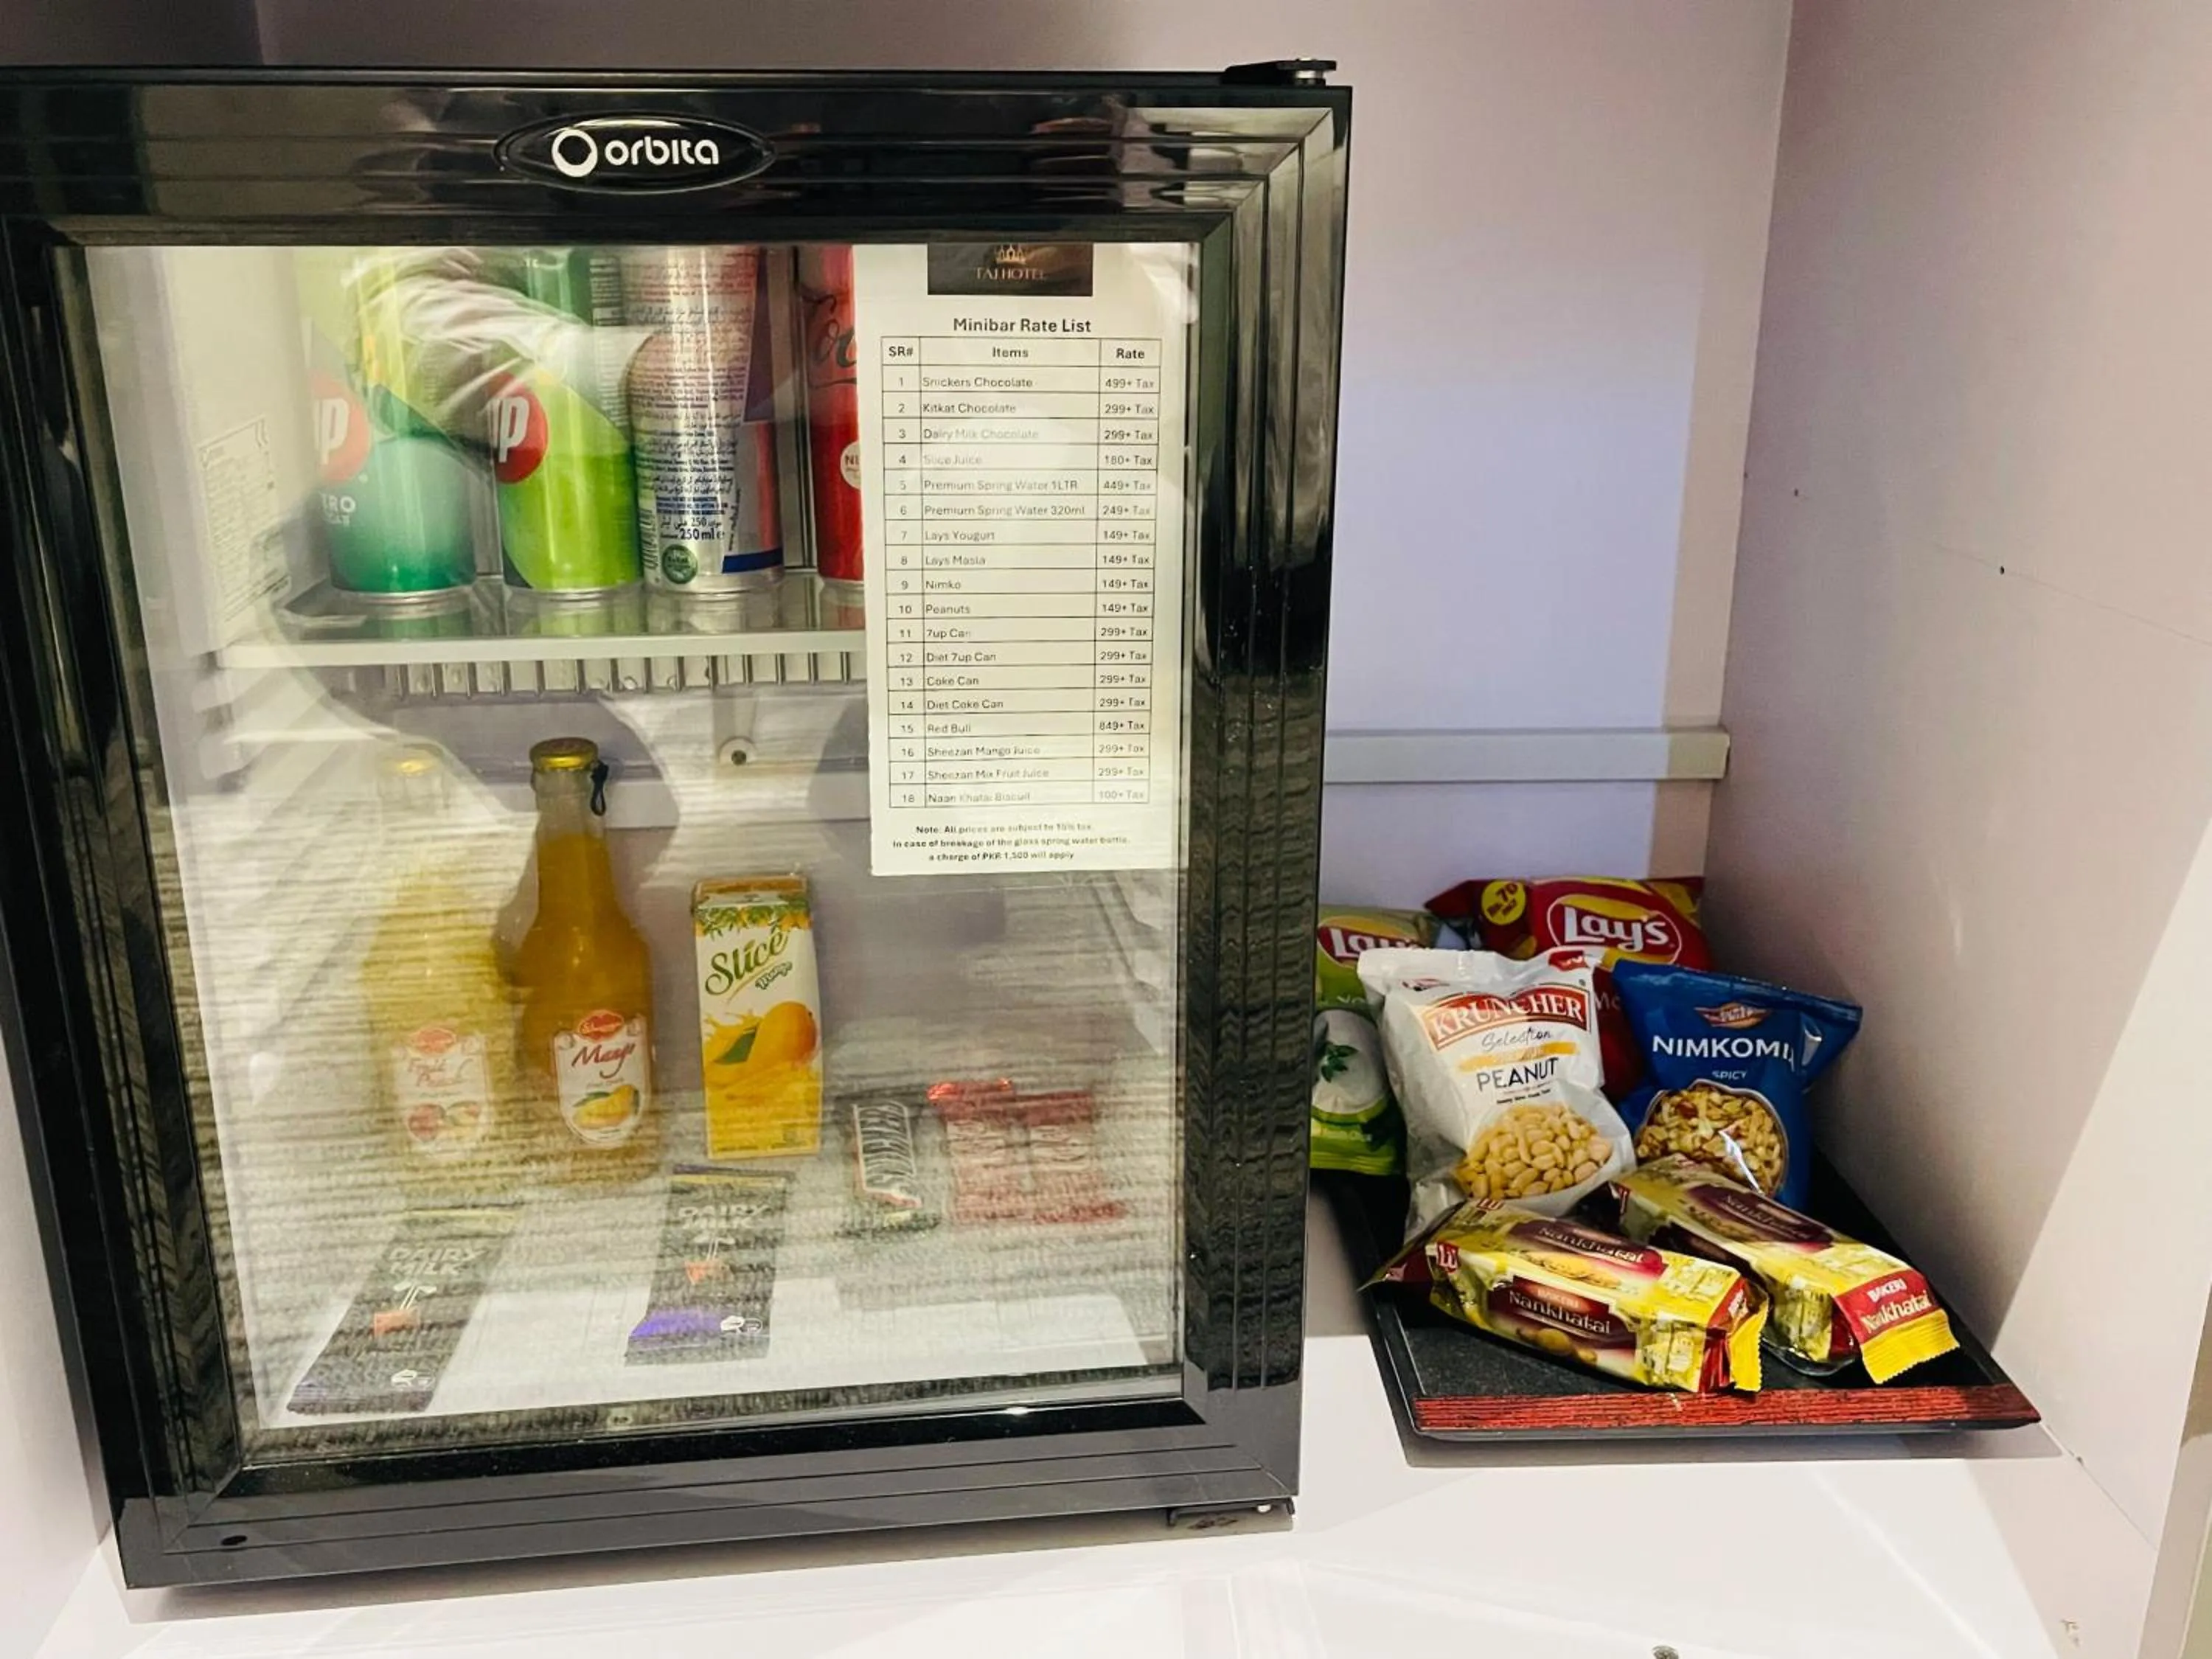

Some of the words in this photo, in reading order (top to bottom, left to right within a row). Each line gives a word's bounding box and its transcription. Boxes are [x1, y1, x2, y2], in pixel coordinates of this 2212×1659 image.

[953, 319, 1016, 332] Minibar
[1020, 319, 1057, 332] Rate
[1062, 319, 1092, 333] List
[888, 346, 914, 357] SR#
[992, 347, 1029, 358] Items
[1116, 347, 1145, 359] Rate
[898, 377, 904, 387] 1
[922, 377, 971, 387] Snickers
[974, 377, 1034, 388] Chocolate
[1105, 378, 1133, 389] 499+
[1135, 379, 1155, 389] Tax
[898, 403, 905, 414] 2
[922, 403, 955, 413] Kitkat
[958, 403, 1017, 414] Chocolate
[1105, 404, 1132, 414] 299+
[1135, 404, 1155, 414] Tax
[898, 429, 906, 439] 3
[923, 429, 954, 440] Dairy
[1104, 431, 1130, 440] 299+
[1135, 431, 1153, 440] Tax
[898, 455, 906, 465] 4
[953, 455, 982, 465] Juice
[1105, 456, 1130, 465] 180+
[1135, 456, 1152, 465] Tax
[900, 481, 906, 490] 5
[924, 480, 975, 490] Premium
[977, 481, 1012, 492] Spring
[1015, 481, 1048, 490] Water
[1103, 481, 1130, 490] 449+
[1134, 481, 1152, 490] Tax
[900, 506, 908, 515] 6
[924, 505, 975, 515] Premium
[977, 506, 1012, 517] Spring
[1015, 506, 1048, 515] Water
[1051, 505, 1085, 515] 320ml
[1103, 506, 1129, 515] 249+
[1133, 506, 1150, 515] Tax
[679, 528, 700, 540] 250
[701, 527, 715, 540] ml
[901, 531, 908, 540] 7
[925, 531, 950, 542] Lays
[952, 531, 995, 542] Yougurt
[1103, 530, 1128, 540] 149+
[1133, 530, 1150, 540] Tax
[900, 556, 908, 566] 8
[925, 555, 950, 567] Lays
[1102, 555, 1127, 565] 149+
[1132, 554, 1150, 564] Tax
[901, 580, 908, 590] 9
[925, 580, 961, 590] Nimko
[1102, 579, 1127, 588] 149+
[1130, 579, 1148, 588] Tax
[899, 605, 912, 614] 10
[925, 604, 971, 614] Peanuts
[1102, 604, 1127, 613] 149+
[1130, 603, 1148, 613] Tax
[899, 629, 911, 639] 11
[926, 628, 947, 640] 7up
[949, 628, 971, 639] Can
[1100, 627, 1126, 637] 299+
[1130, 627, 1147, 636] Tax
[900, 653, 913, 663] 12
[926, 653, 947, 662] Diet
[950, 653, 973, 664] 7up
[974, 653, 997, 662] Can
[1100, 651, 1125, 661] 299+
[1129, 651, 1147, 661] Tax
[900, 677, 914, 686] 13
[927, 676, 955, 686] Coke
[958, 676, 979, 686] Can
[1099, 675, 1124, 684] 299+
[1128, 675, 1146, 684] Tax
[900, 700, 914, 710] 14
[927, 700, 949, 710] Diet
[952, 700, 980, 709] Coke
[981, 699, 1004, 709] Can
[1099, 698, 1124, 707] 299+
[1128, 698, 1146, 706] Tax
[901, 725, 914, 734] 15
[927, 724, 948, 734] Red
[950, 724, 972, 734] Bull
[1099, 721, 1124, 731] 849+
[1127, 720, 1145, 730] Tax
[902, 748, 915, 757] 16
[928, 747, 973, 757] Sheezan
[975, 746, 1011, 757] Mango
[1099, 744, 1124, 754] 299+
[1127, 744, 1144, 754] Tax
[902, 771, 914, 780] 17
[975, 769, 993, 779] Mix
[996, 769, 1020, 778] Fruit
[1022, 768, 1049, 778] Juice
[1098, 768, 1123, 777] 299+
[1127, 767, 1144, 776] Tax
[902, 794, 915, 803] 18
[928, 793, 956, 803] Naan
[994, 791, 1031, 801] Biscuit
[944, 825, 957, 833] All
[959, 825, 988, 835] prices
[990, 825, 1005, 833] are
[893, 839, 902, 848] In
[904, 840, 926, 848] case
[928, 840, 939, 848] of
[940, 839, 984, 849] breakage
[986, 838, 995, 847] of
[1014, 837, 1040, 847] glass
[1041, 837, 1070, 846] spring
[1071, 837, 1099, 845] water
[936, 852, 970, 862] charge
[971, 852, 981, 861] of
[982, 852, 1002, 860] PKR
[1031, 851, 1046, 860] will
[1564, 905, 1670, 953] Lay's
[705, 931, 789, 996] Slice
[1431, 992, 1585, 1039] KRUNCHER
[1481, 1026, 1551, 1052] Selection
[1476, 1057, 1559, 1092] PEANUT
[1711, 1070, 1747, 1080] SPICY
[1509, 1290, 1611, 1335] Nankhatai
